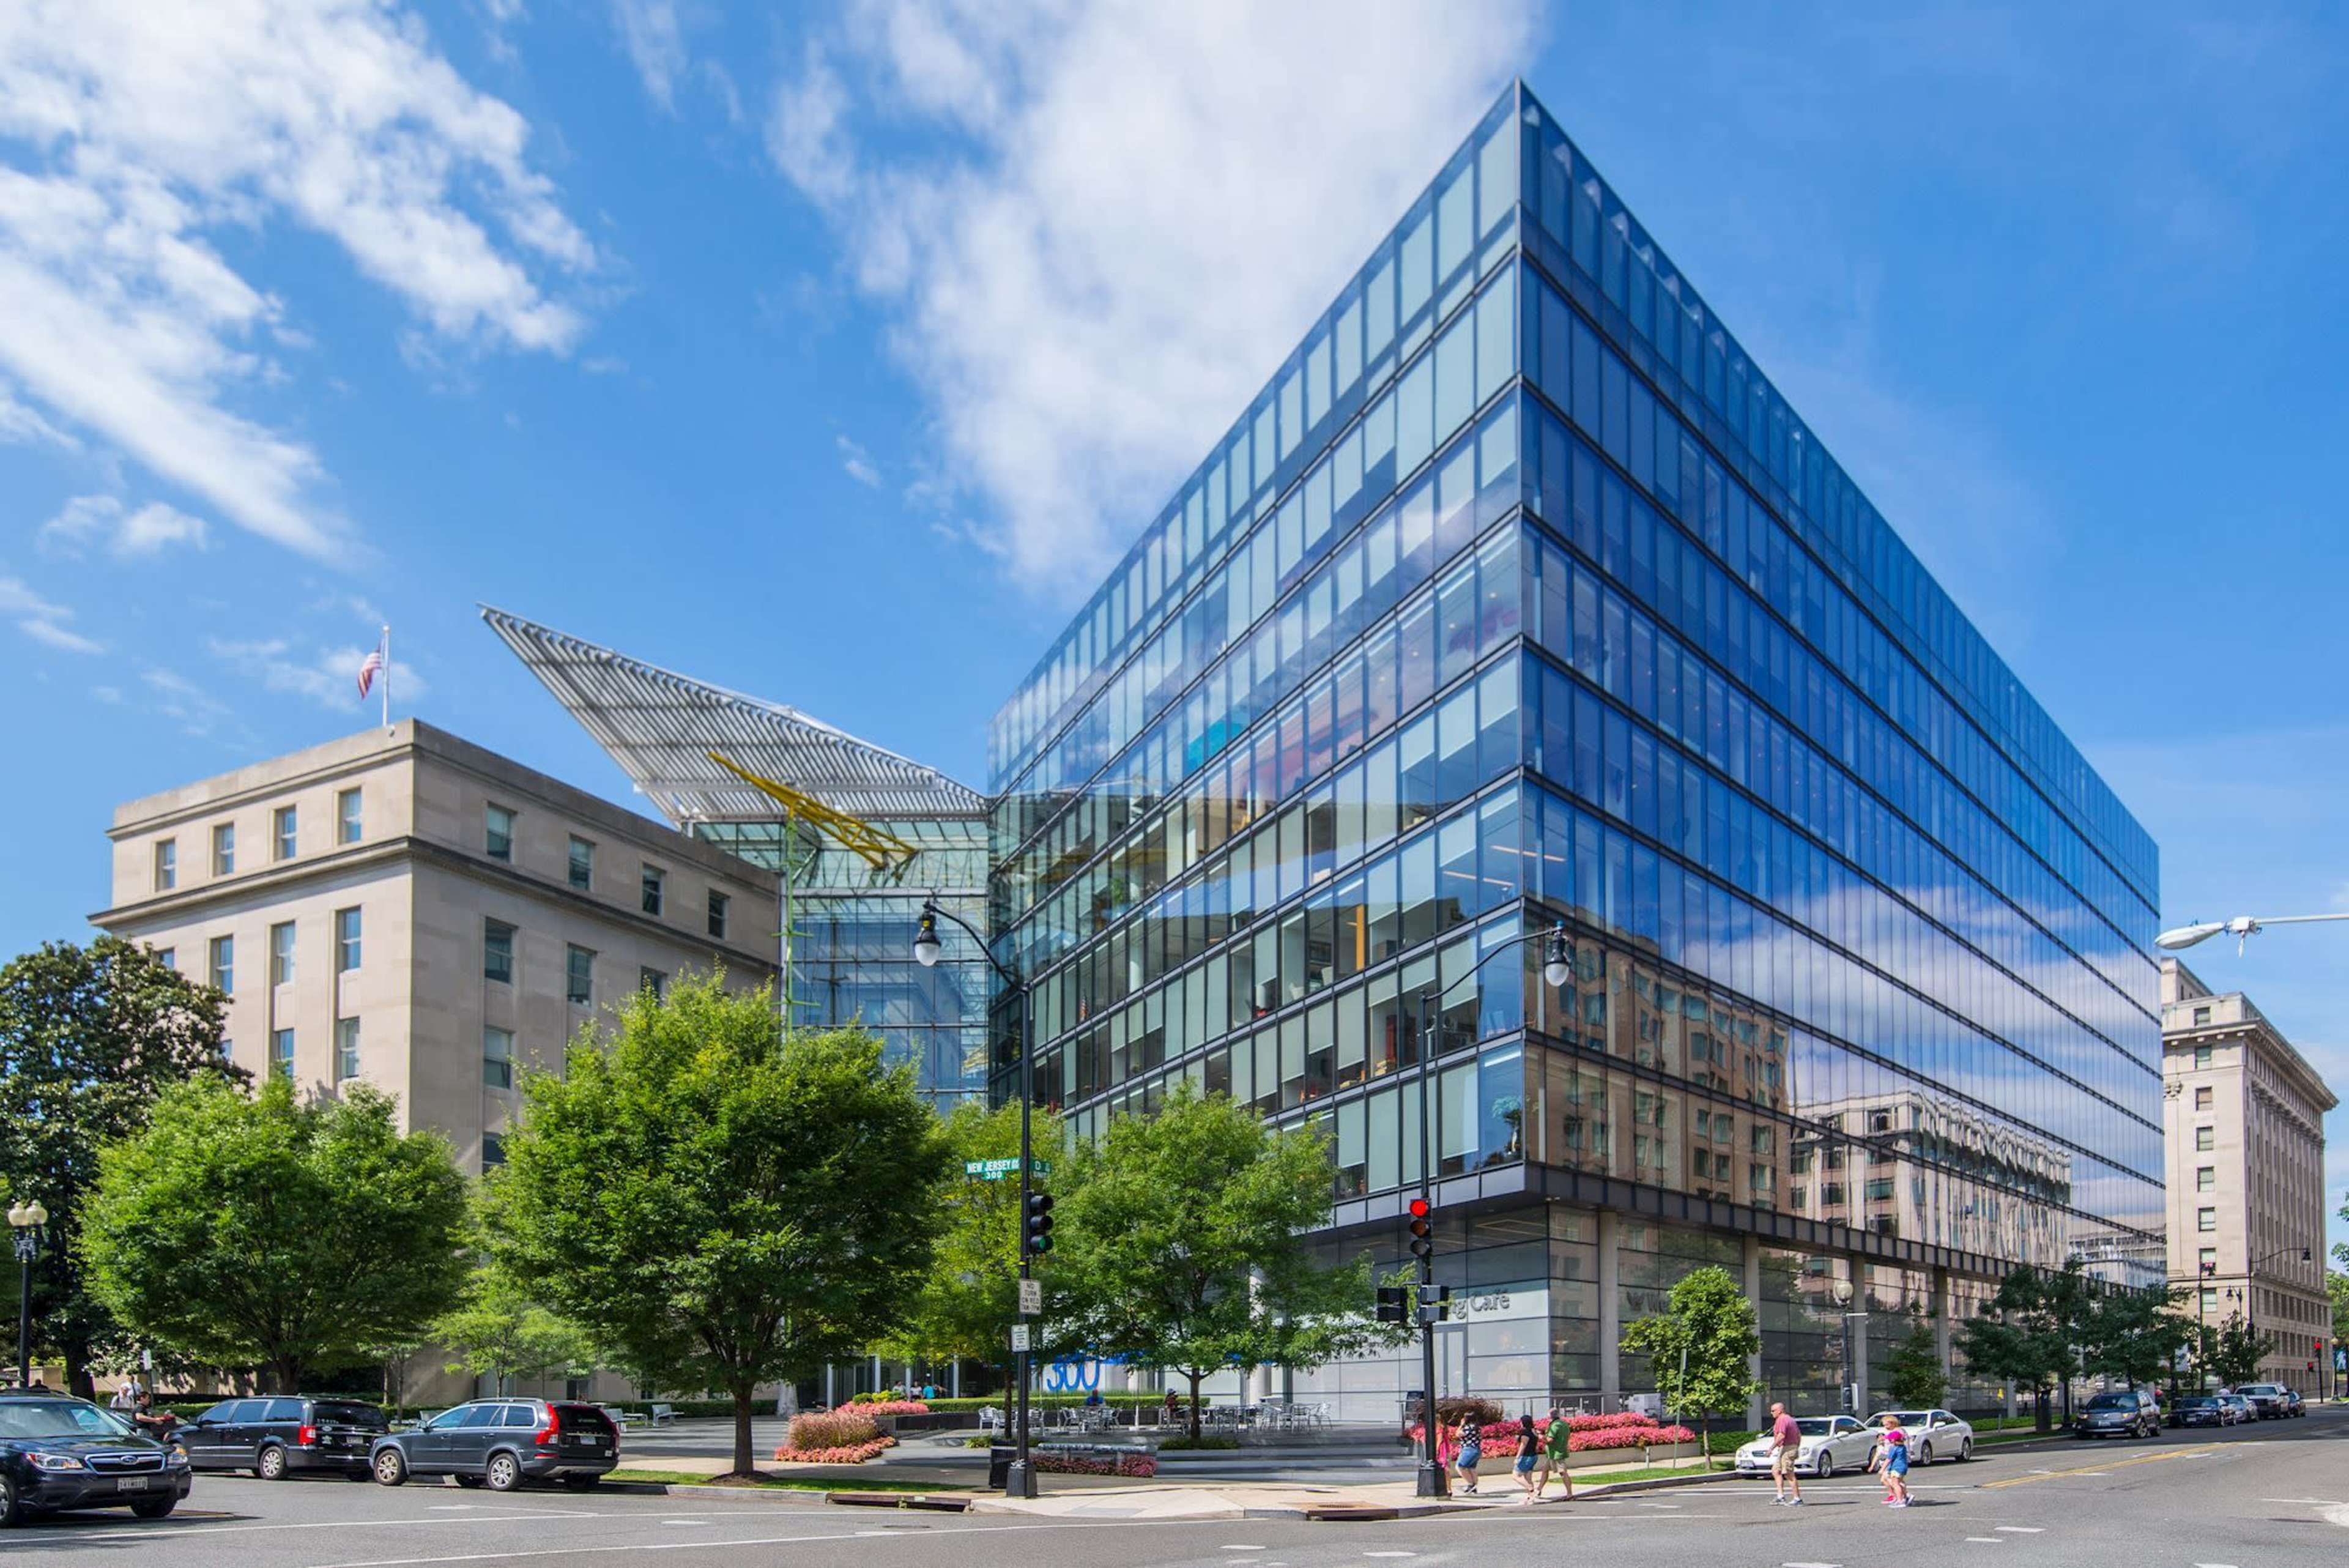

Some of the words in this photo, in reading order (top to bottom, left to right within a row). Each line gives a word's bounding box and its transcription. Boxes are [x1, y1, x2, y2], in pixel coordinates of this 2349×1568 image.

[967, 1162, 982, 1174] NEW
[985, 1159, 1011, 1172] JERSEY
[1035, 1161, 1041, 1170] D
